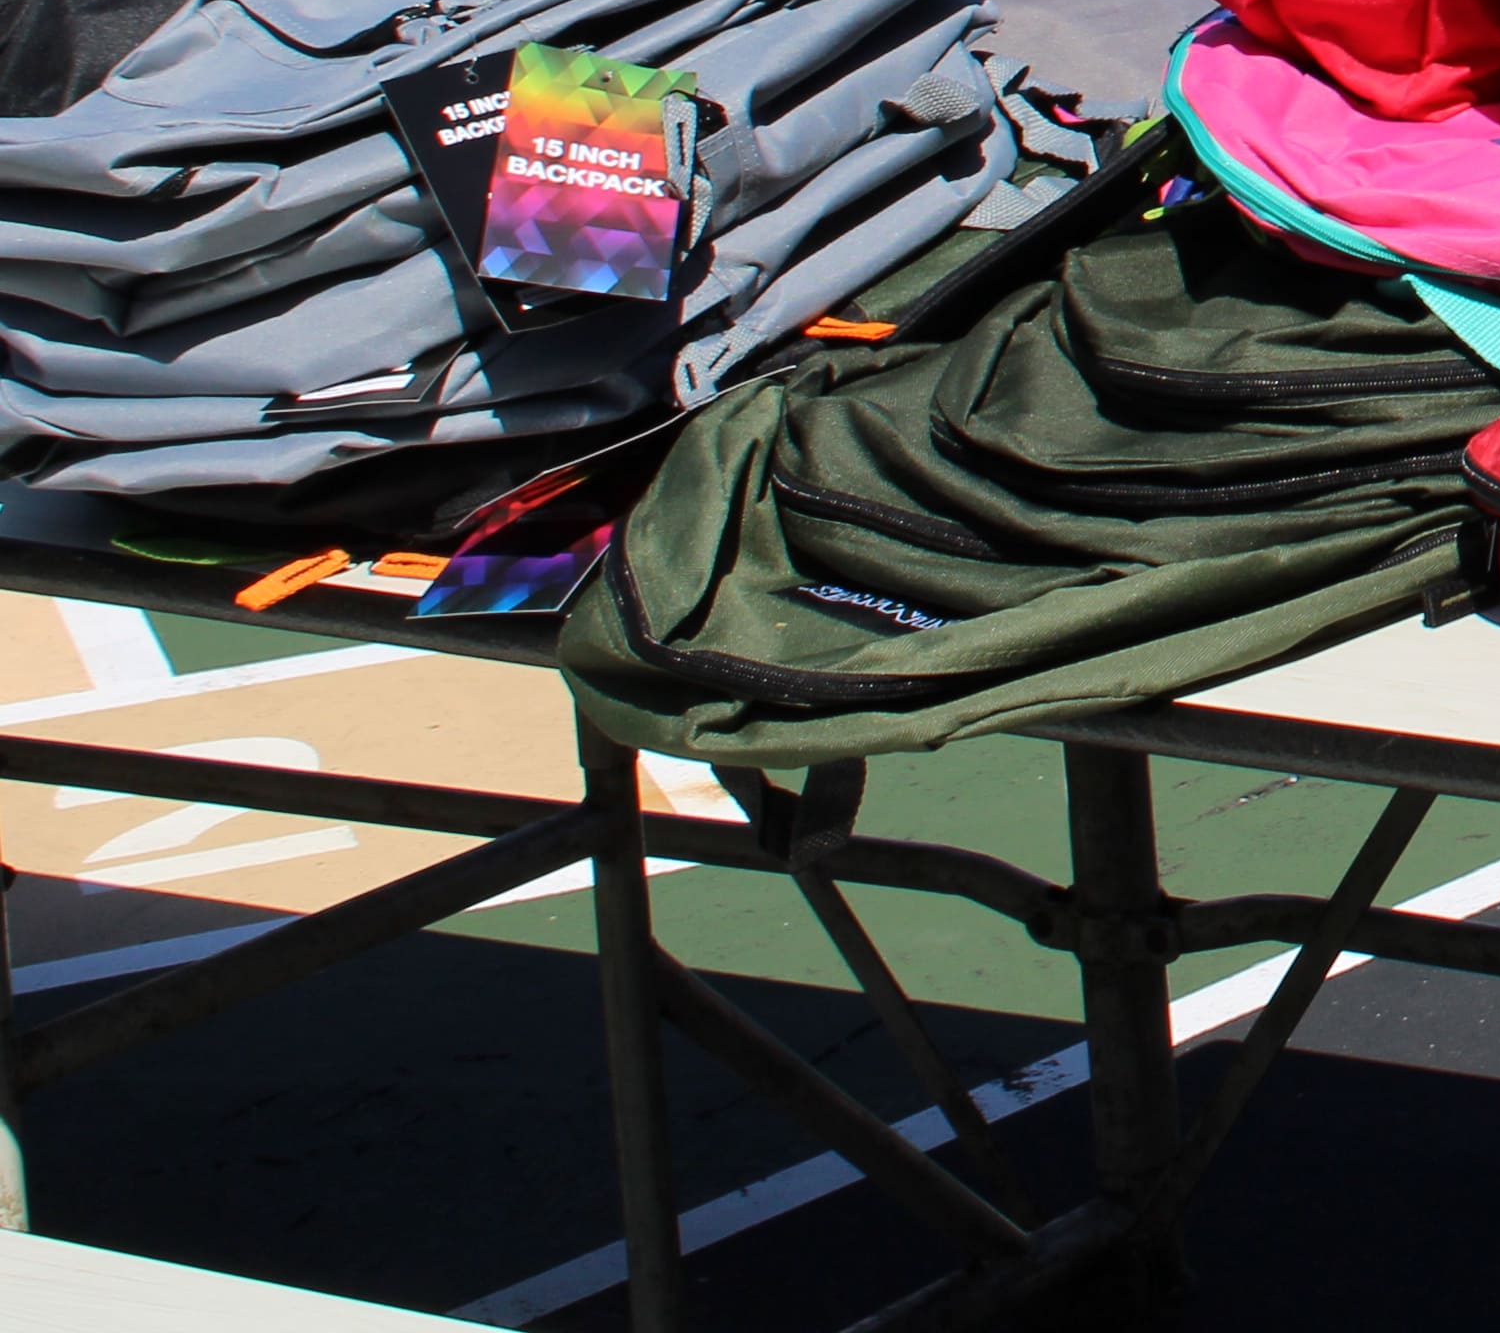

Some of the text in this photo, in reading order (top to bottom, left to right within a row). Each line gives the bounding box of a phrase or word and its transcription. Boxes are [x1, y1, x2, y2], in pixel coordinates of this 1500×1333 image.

[442, 90, 511, 121] 15 INC
[532, 137, 641, 171] 15 INCH
[507, 155, 665, 198] BACKPACK
